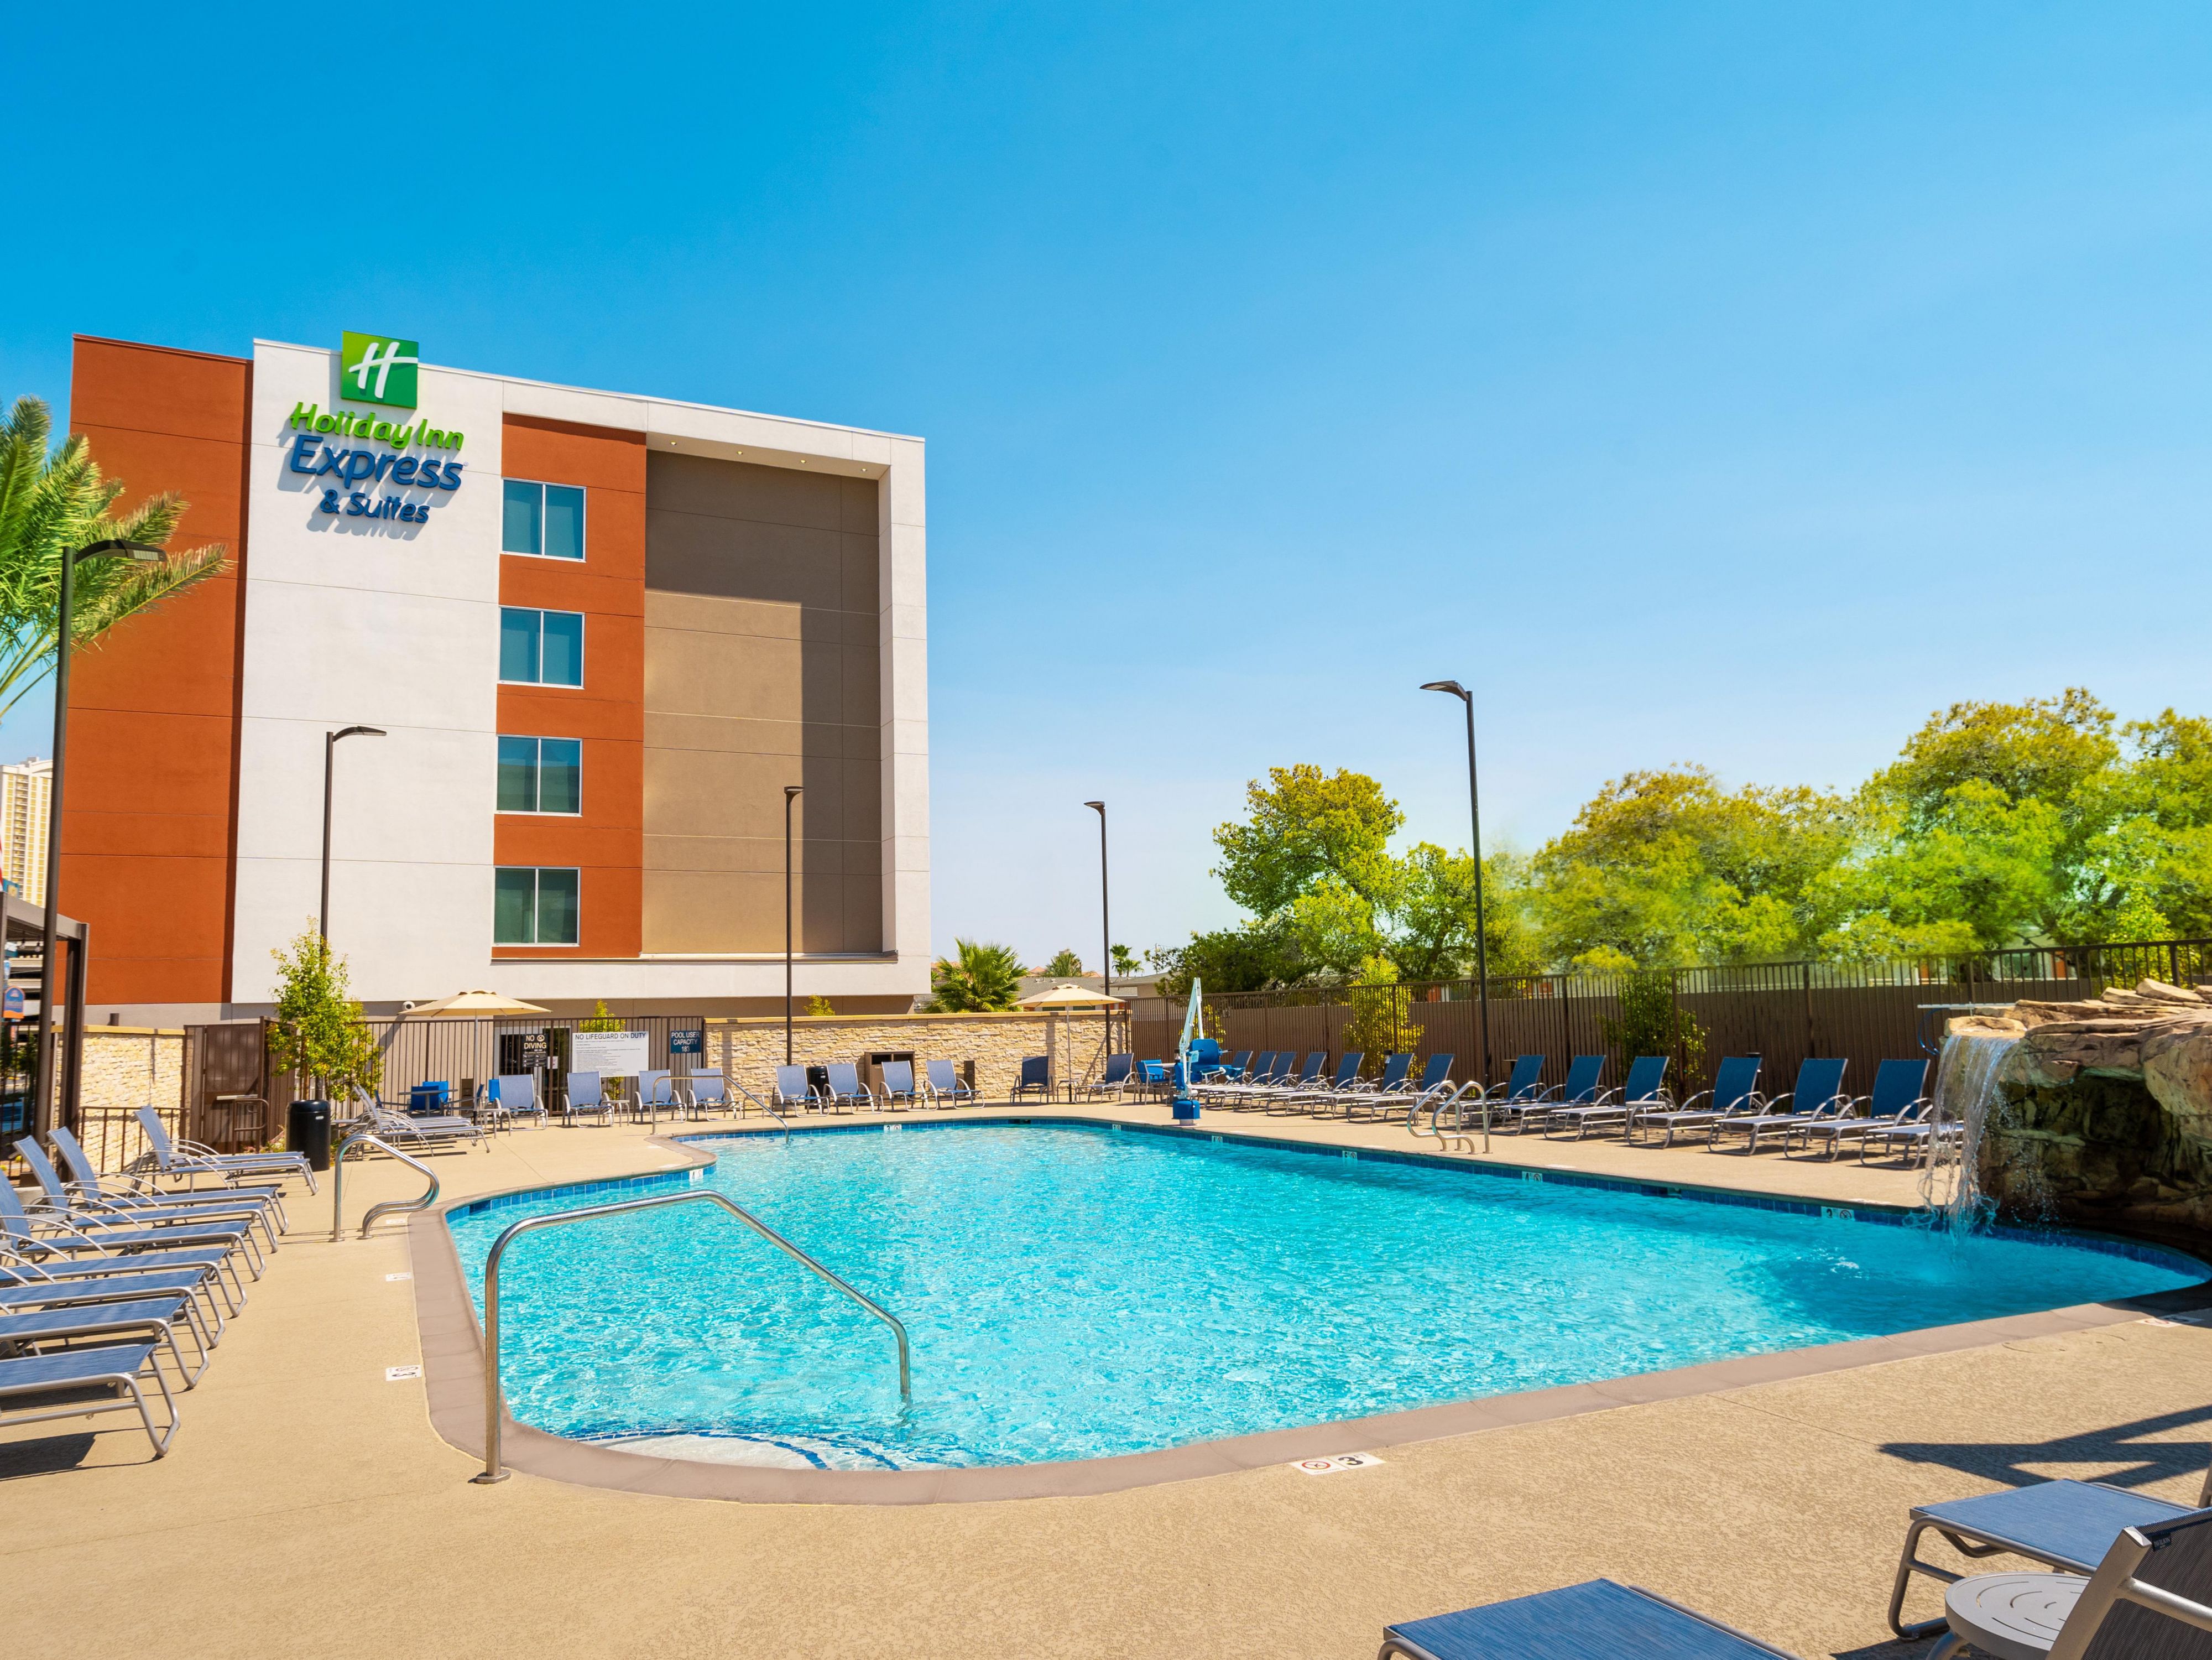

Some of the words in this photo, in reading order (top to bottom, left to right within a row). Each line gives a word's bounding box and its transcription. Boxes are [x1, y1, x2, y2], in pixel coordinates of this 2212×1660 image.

[349, 342, 418, 398] H
[290, 402, 413, 449] Holiday
[417, 419, 464, 450] Inn
[290, 435, 463, 491] Express
[320, 490, 340, 514] &
[347, 492, 430, 523] Suites
[1338, 1456, 1364, 1465] 3
